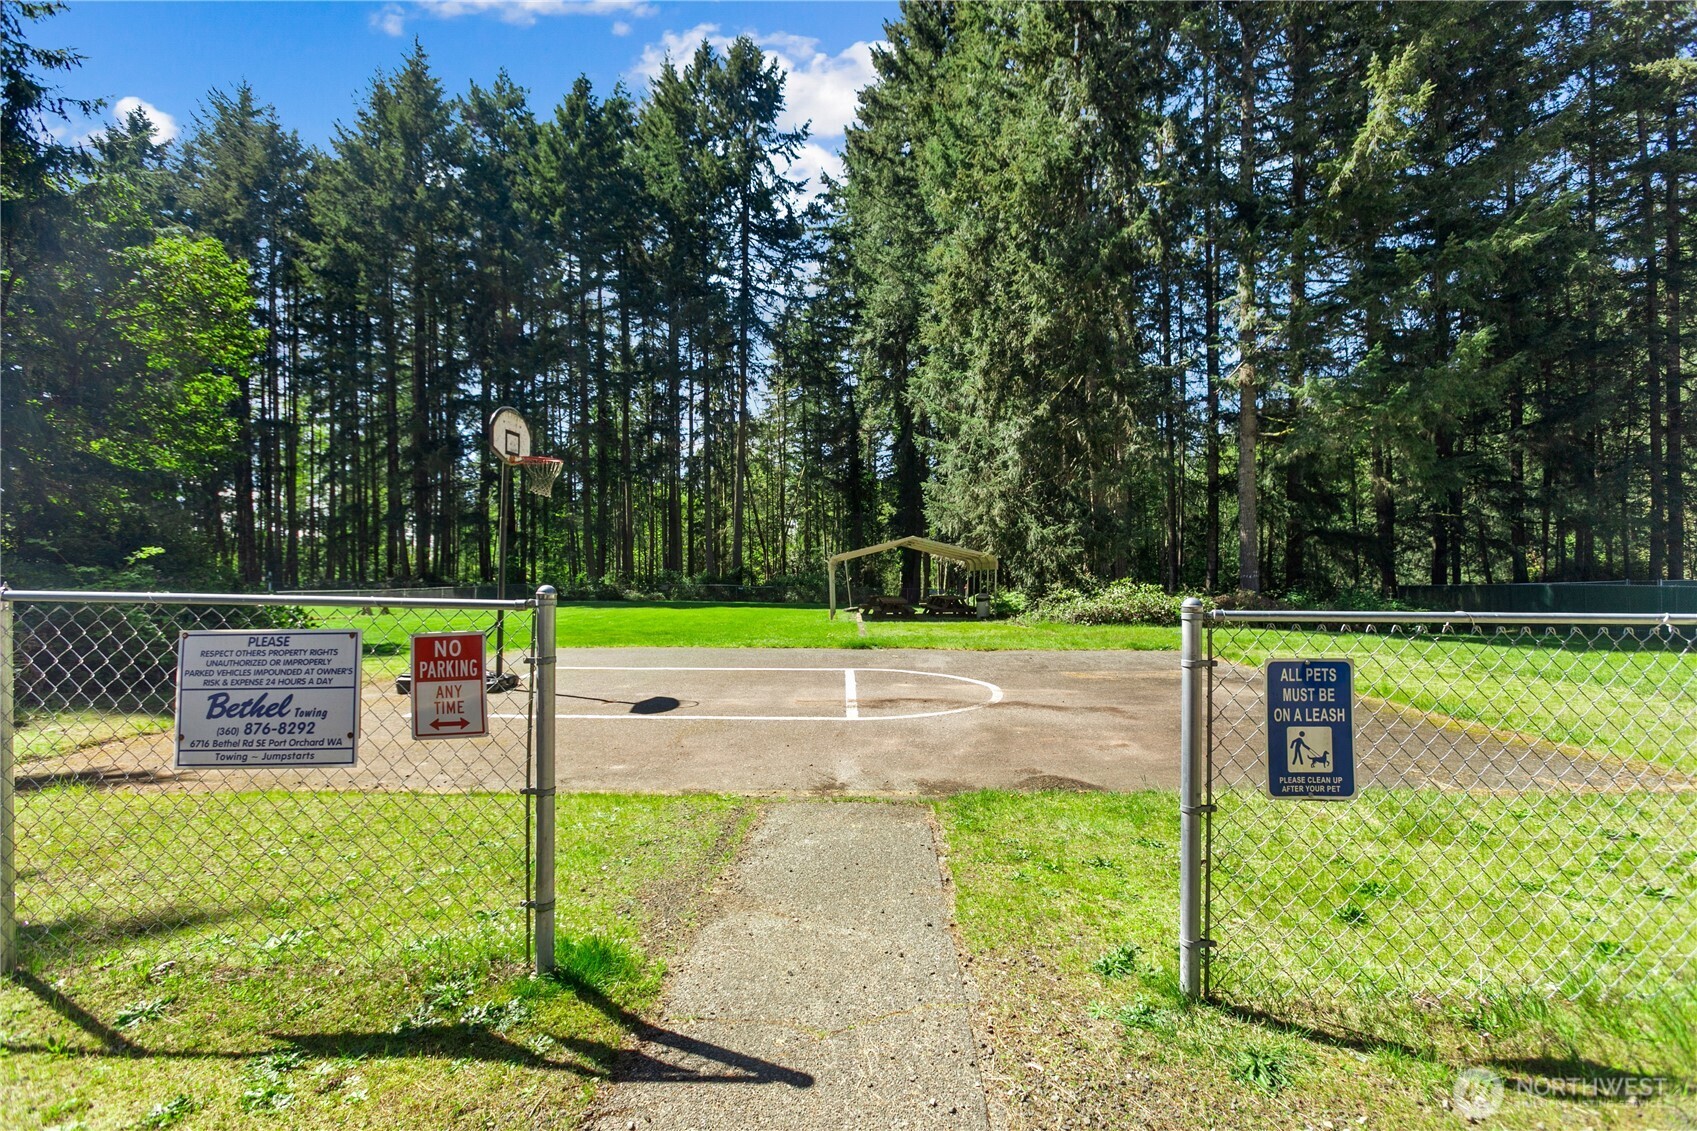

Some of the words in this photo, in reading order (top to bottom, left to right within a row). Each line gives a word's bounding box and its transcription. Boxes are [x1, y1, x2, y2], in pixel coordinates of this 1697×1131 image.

[248, 636, 290, 647] PLEASE
[434, 640, 461, 657] NO
[420, 659, 477, 678] PARKING
[1280, 668, 1302, 681] ALL
[1306, 668, 1336, 681] PETS
[436, 685, 462, 698] ANY
[1283, 688, 1315, 701] MUST
[1319, 688, 1335, 701] BE
[206, 692, 294, 719] Bethel
[294, 707, 328, 719] Towing
[434, 701, 464, 714] TIME
[1274, 708, 1290, 722] ON
[1294, 708, 1302, 722] A
[1306, 708, 1345, 722] LEASH
[217, 727, 240, 736] (360)
[243, 722, 315, 735] 876-8292
[212, 739, 240, 747] Bethel
[215, 752, 248, 762] Towing
[261, 752, 315, 761] Jumpstarts
